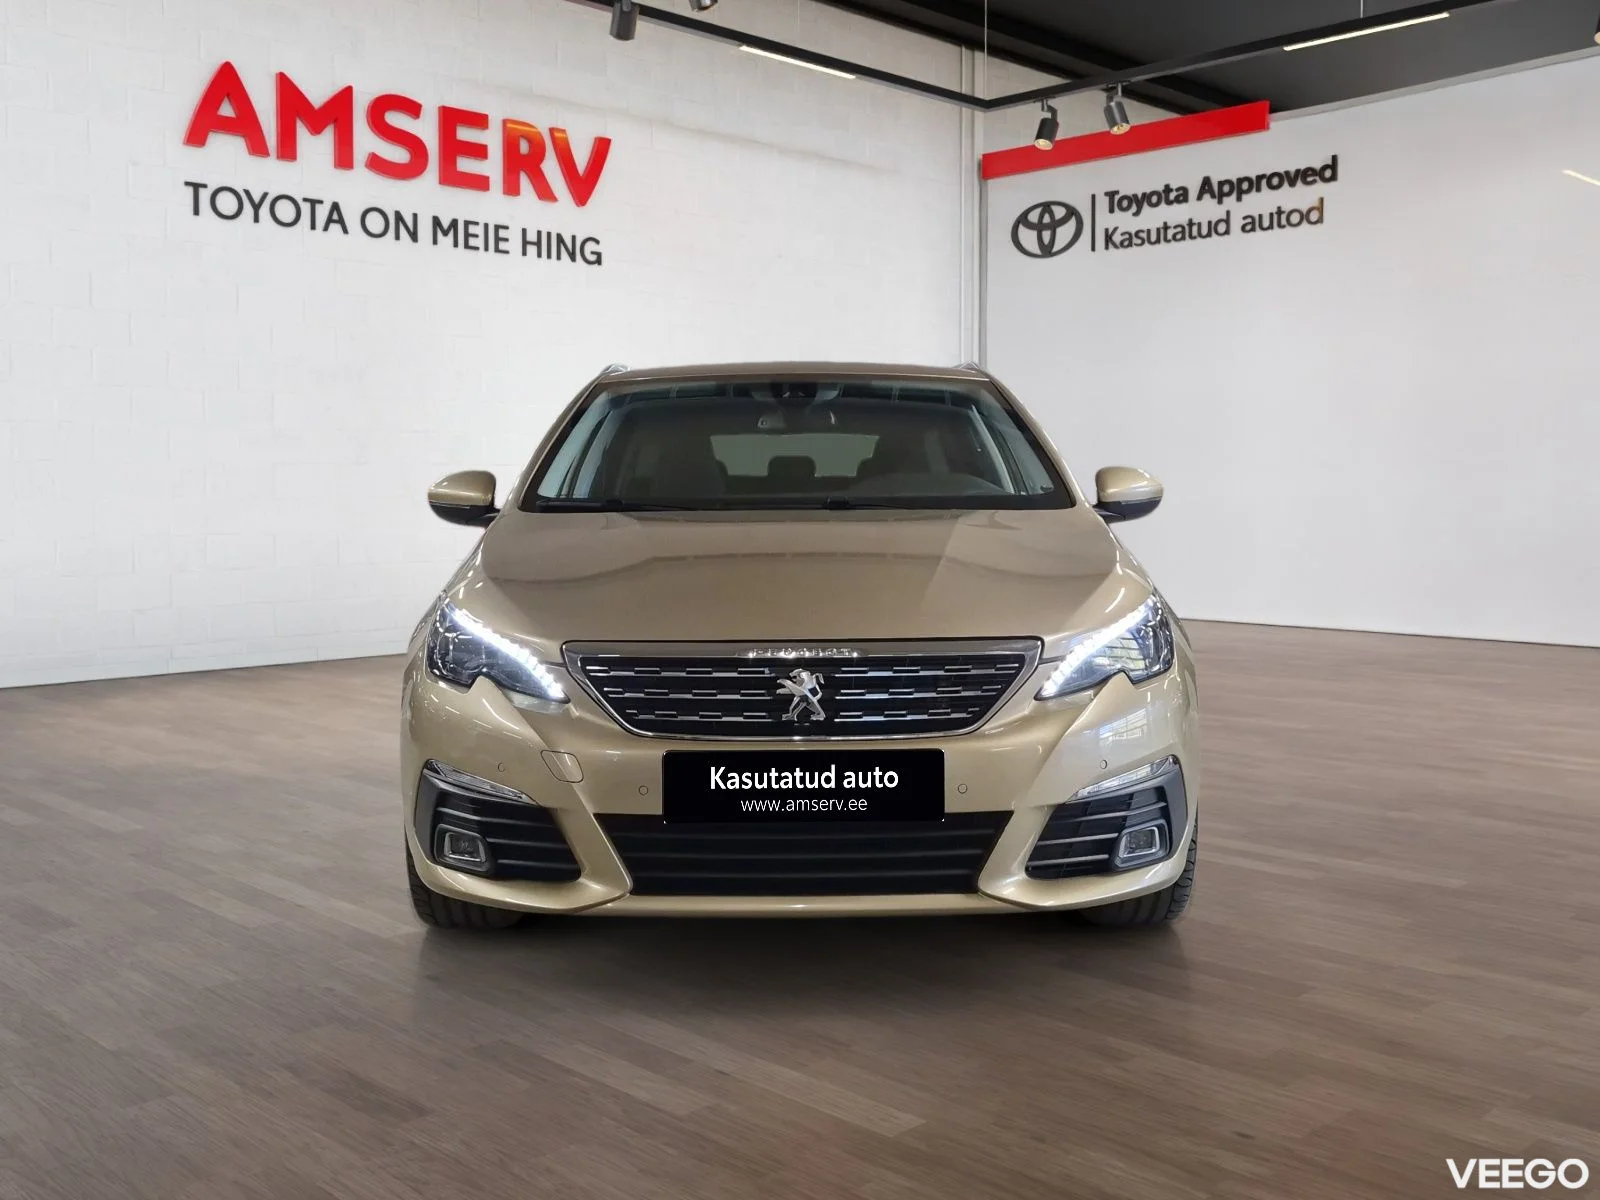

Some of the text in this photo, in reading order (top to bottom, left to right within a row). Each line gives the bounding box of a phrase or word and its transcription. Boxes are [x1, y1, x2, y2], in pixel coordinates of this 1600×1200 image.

[183, 61, 611, 207] AMSERV
[1104, 154, 1338, 217] Toyota Approved
[184, 181, 602, 266] TOYOTA ON MEIE HING
[1104, 197, 1325, 251] Kasutatud autod
[710, 764, 899, 789] Kasutatud auto
[740, 798, 868, 812] www.amserv.ee
